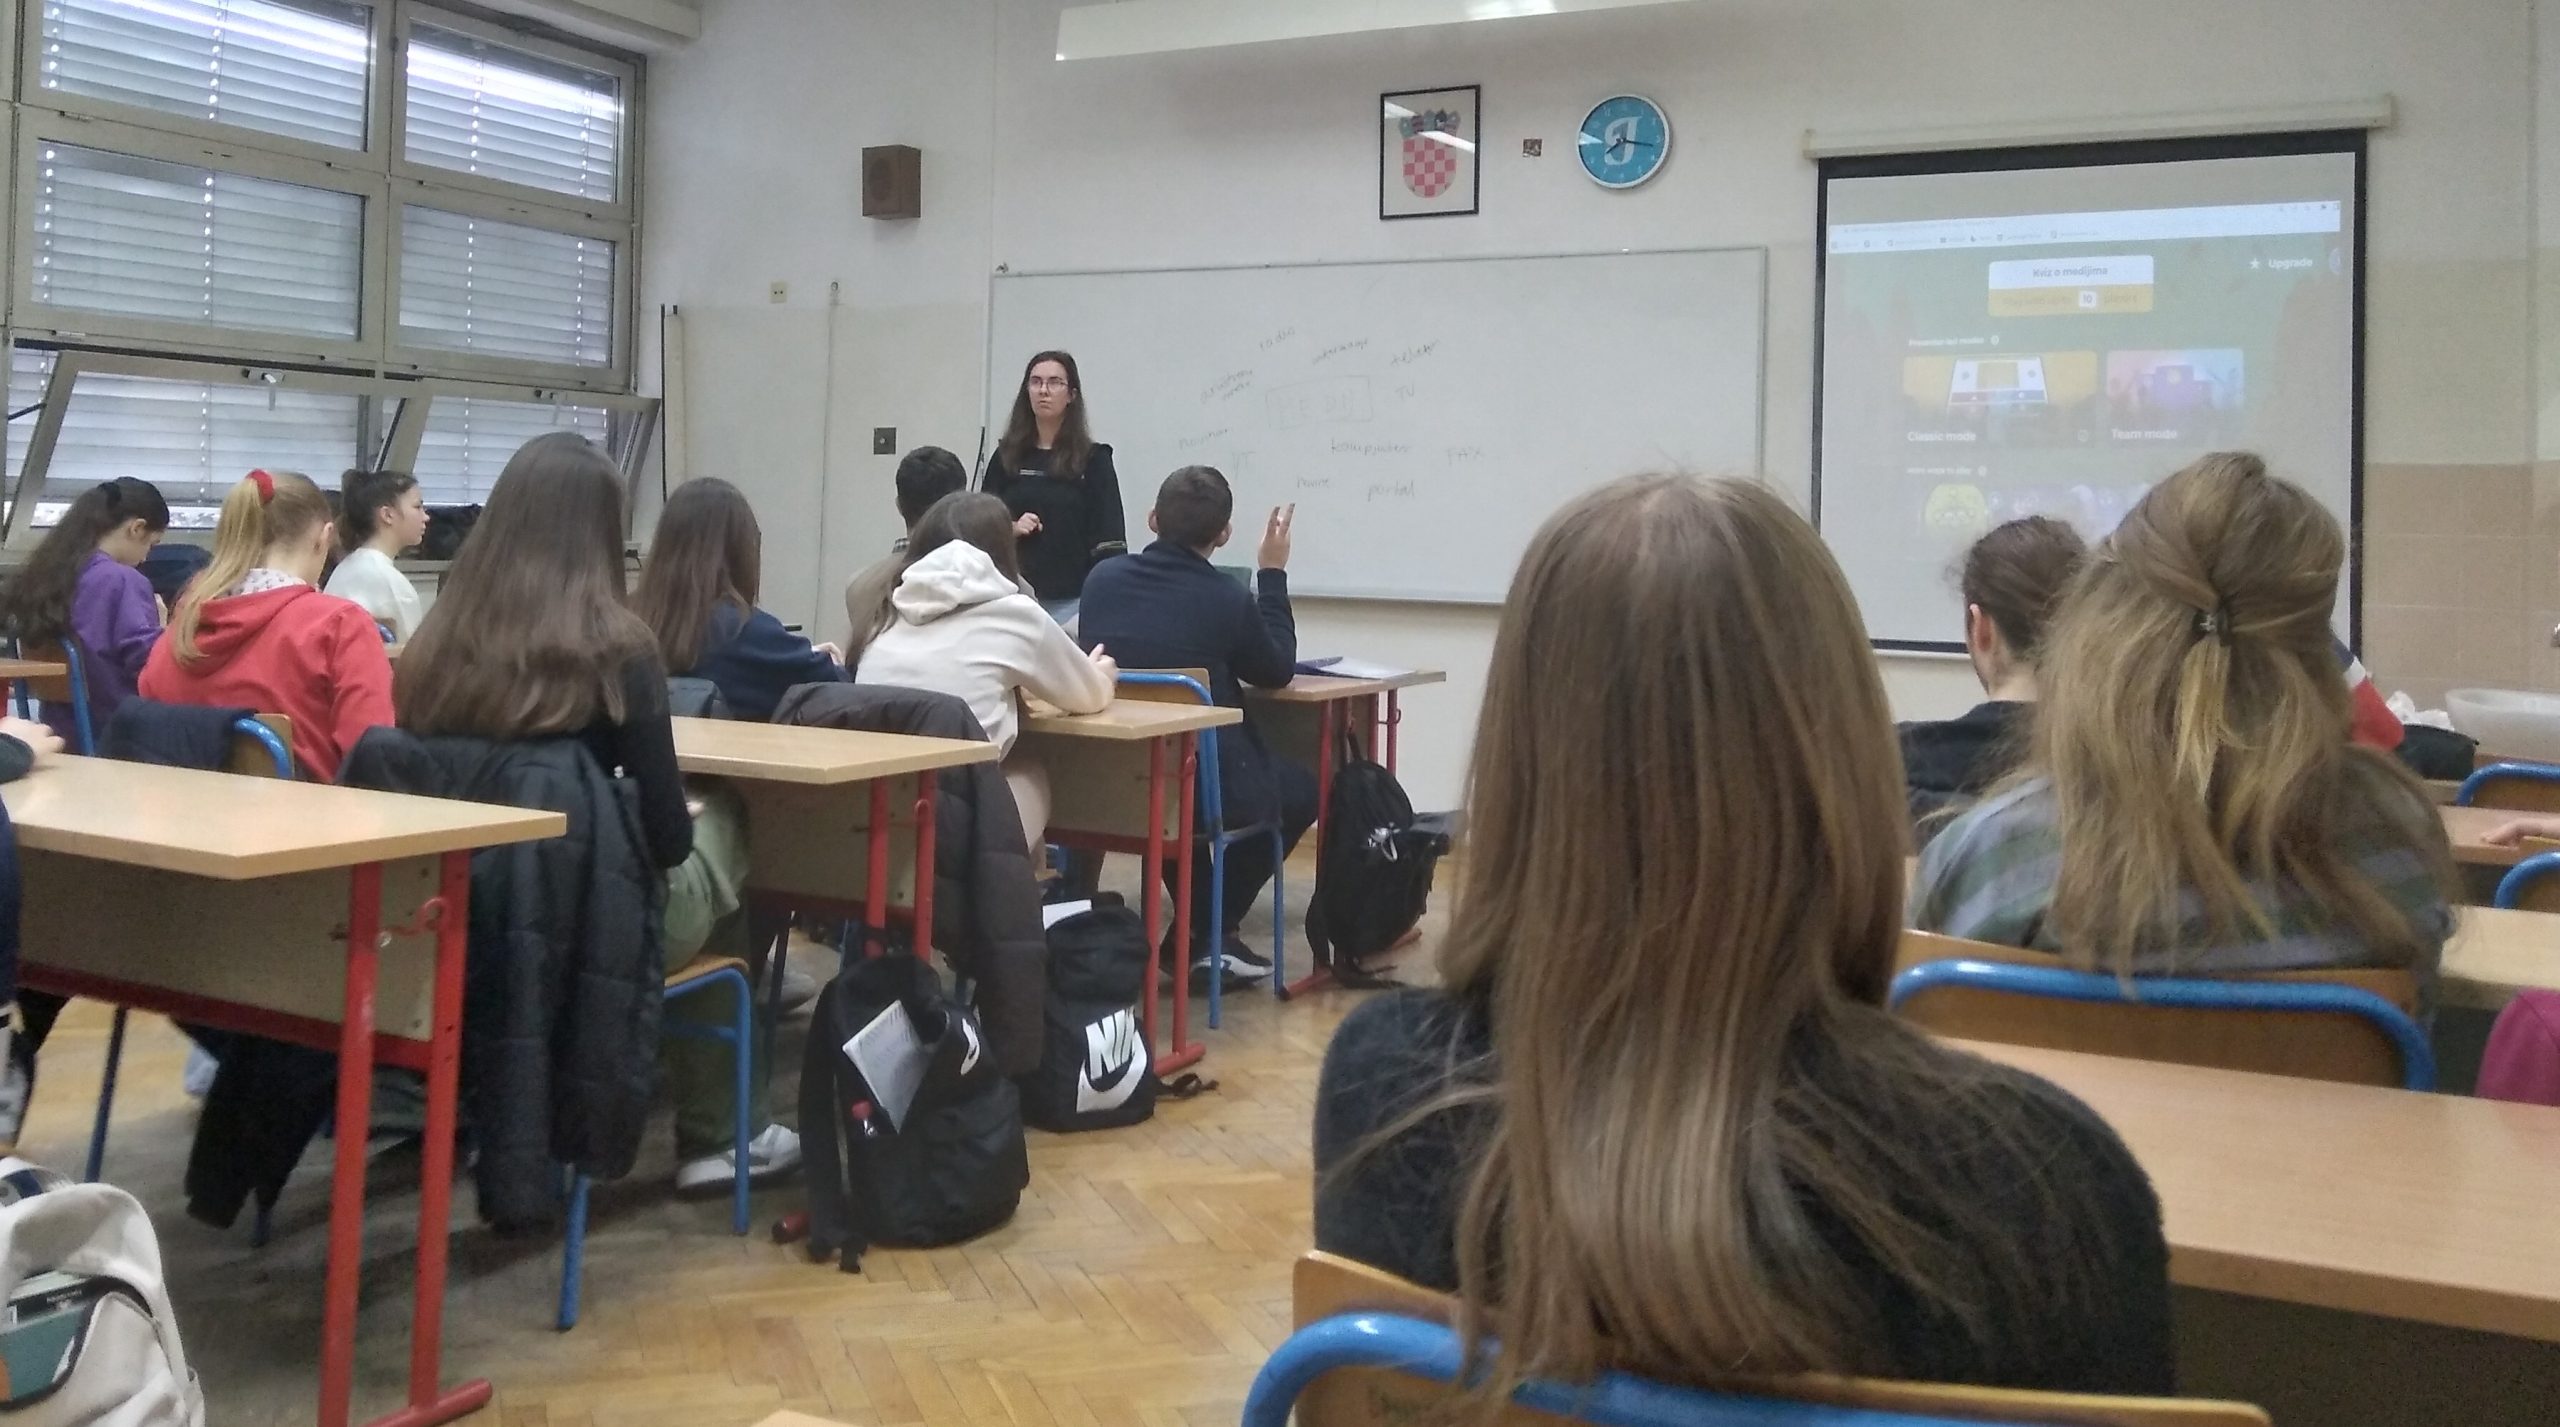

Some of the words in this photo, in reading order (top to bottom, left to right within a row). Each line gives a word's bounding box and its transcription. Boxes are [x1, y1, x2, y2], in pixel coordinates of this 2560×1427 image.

[2268, 258, 2313, 270] Upgrade
[2032, 267, 2052, 278] Kviz
[2062, 266, 2108, 278] medijima
[2082, 293, 2093, 304] 10
[1907, 430, 1944, 441] Classic
[1946, 430, 1977, 441] mode
[2111, 428, 2142, 440] Team
[2144, 428, 2178, 440] mode
[1367, 479, 1415, 502] portal
